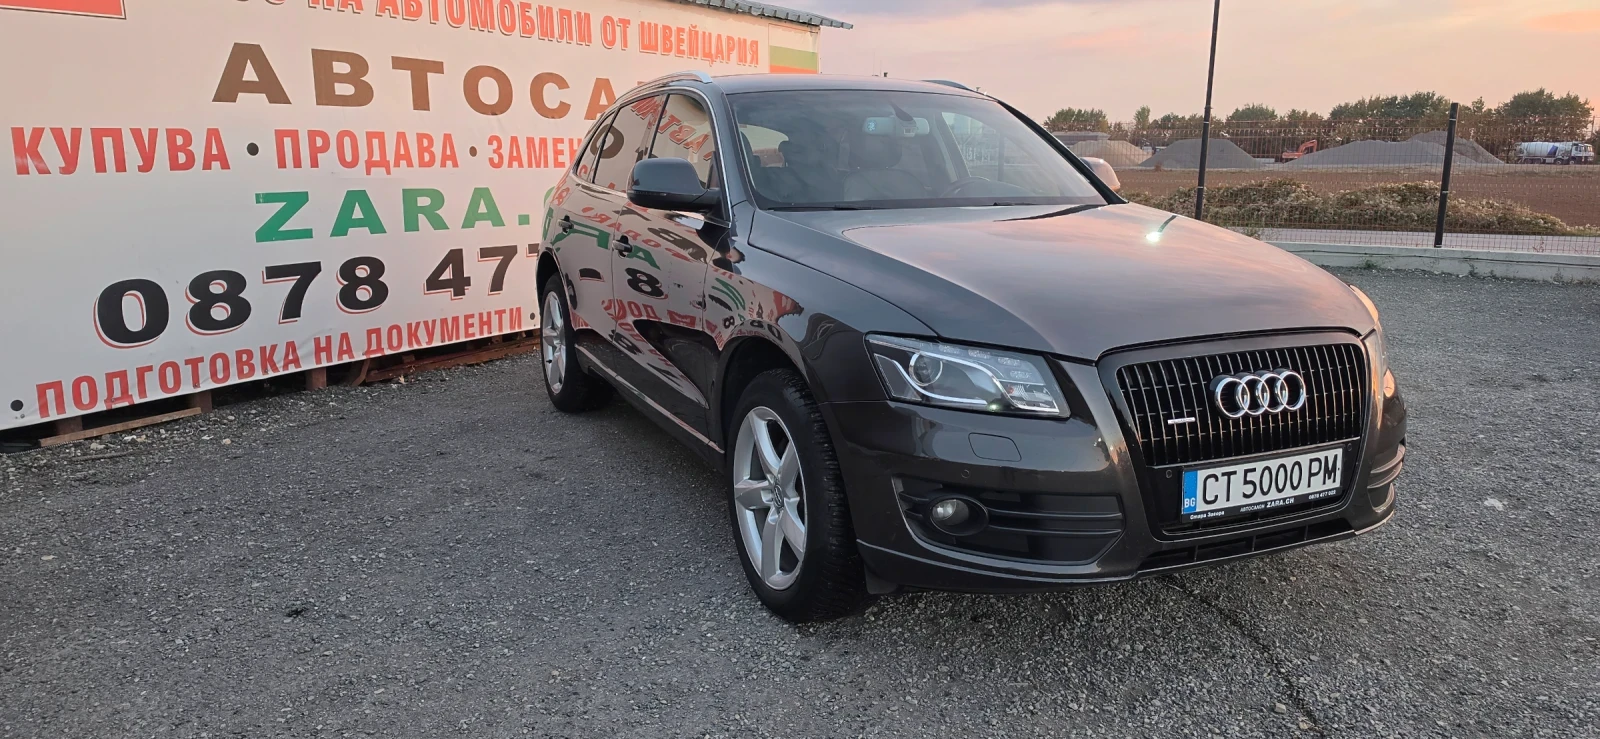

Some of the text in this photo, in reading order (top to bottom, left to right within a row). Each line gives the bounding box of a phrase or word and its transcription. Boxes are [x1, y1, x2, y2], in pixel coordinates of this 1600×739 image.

[601, 15, 631, 51] ОТ
[638, 20, 759, 67] ШВЕЙЦАРИЯ
[212, 42, 655, 120] АВТОСА
[10, 127, 231, 175] КУПУВА
[274, 128, 459, 176] ПРОДАВА
[254, 186, 555, 243] ZARA.
[93, 256, 389, 349] 0878
[36, 306, 522, 418] ПОДГОТОВКА НА ДОКУМЕНТИ
[1183, 496, 1196, 509] BG
[1242, 460, 1303, 499] 5000
[1266, 497, 1295, 508] ZARA.CH
